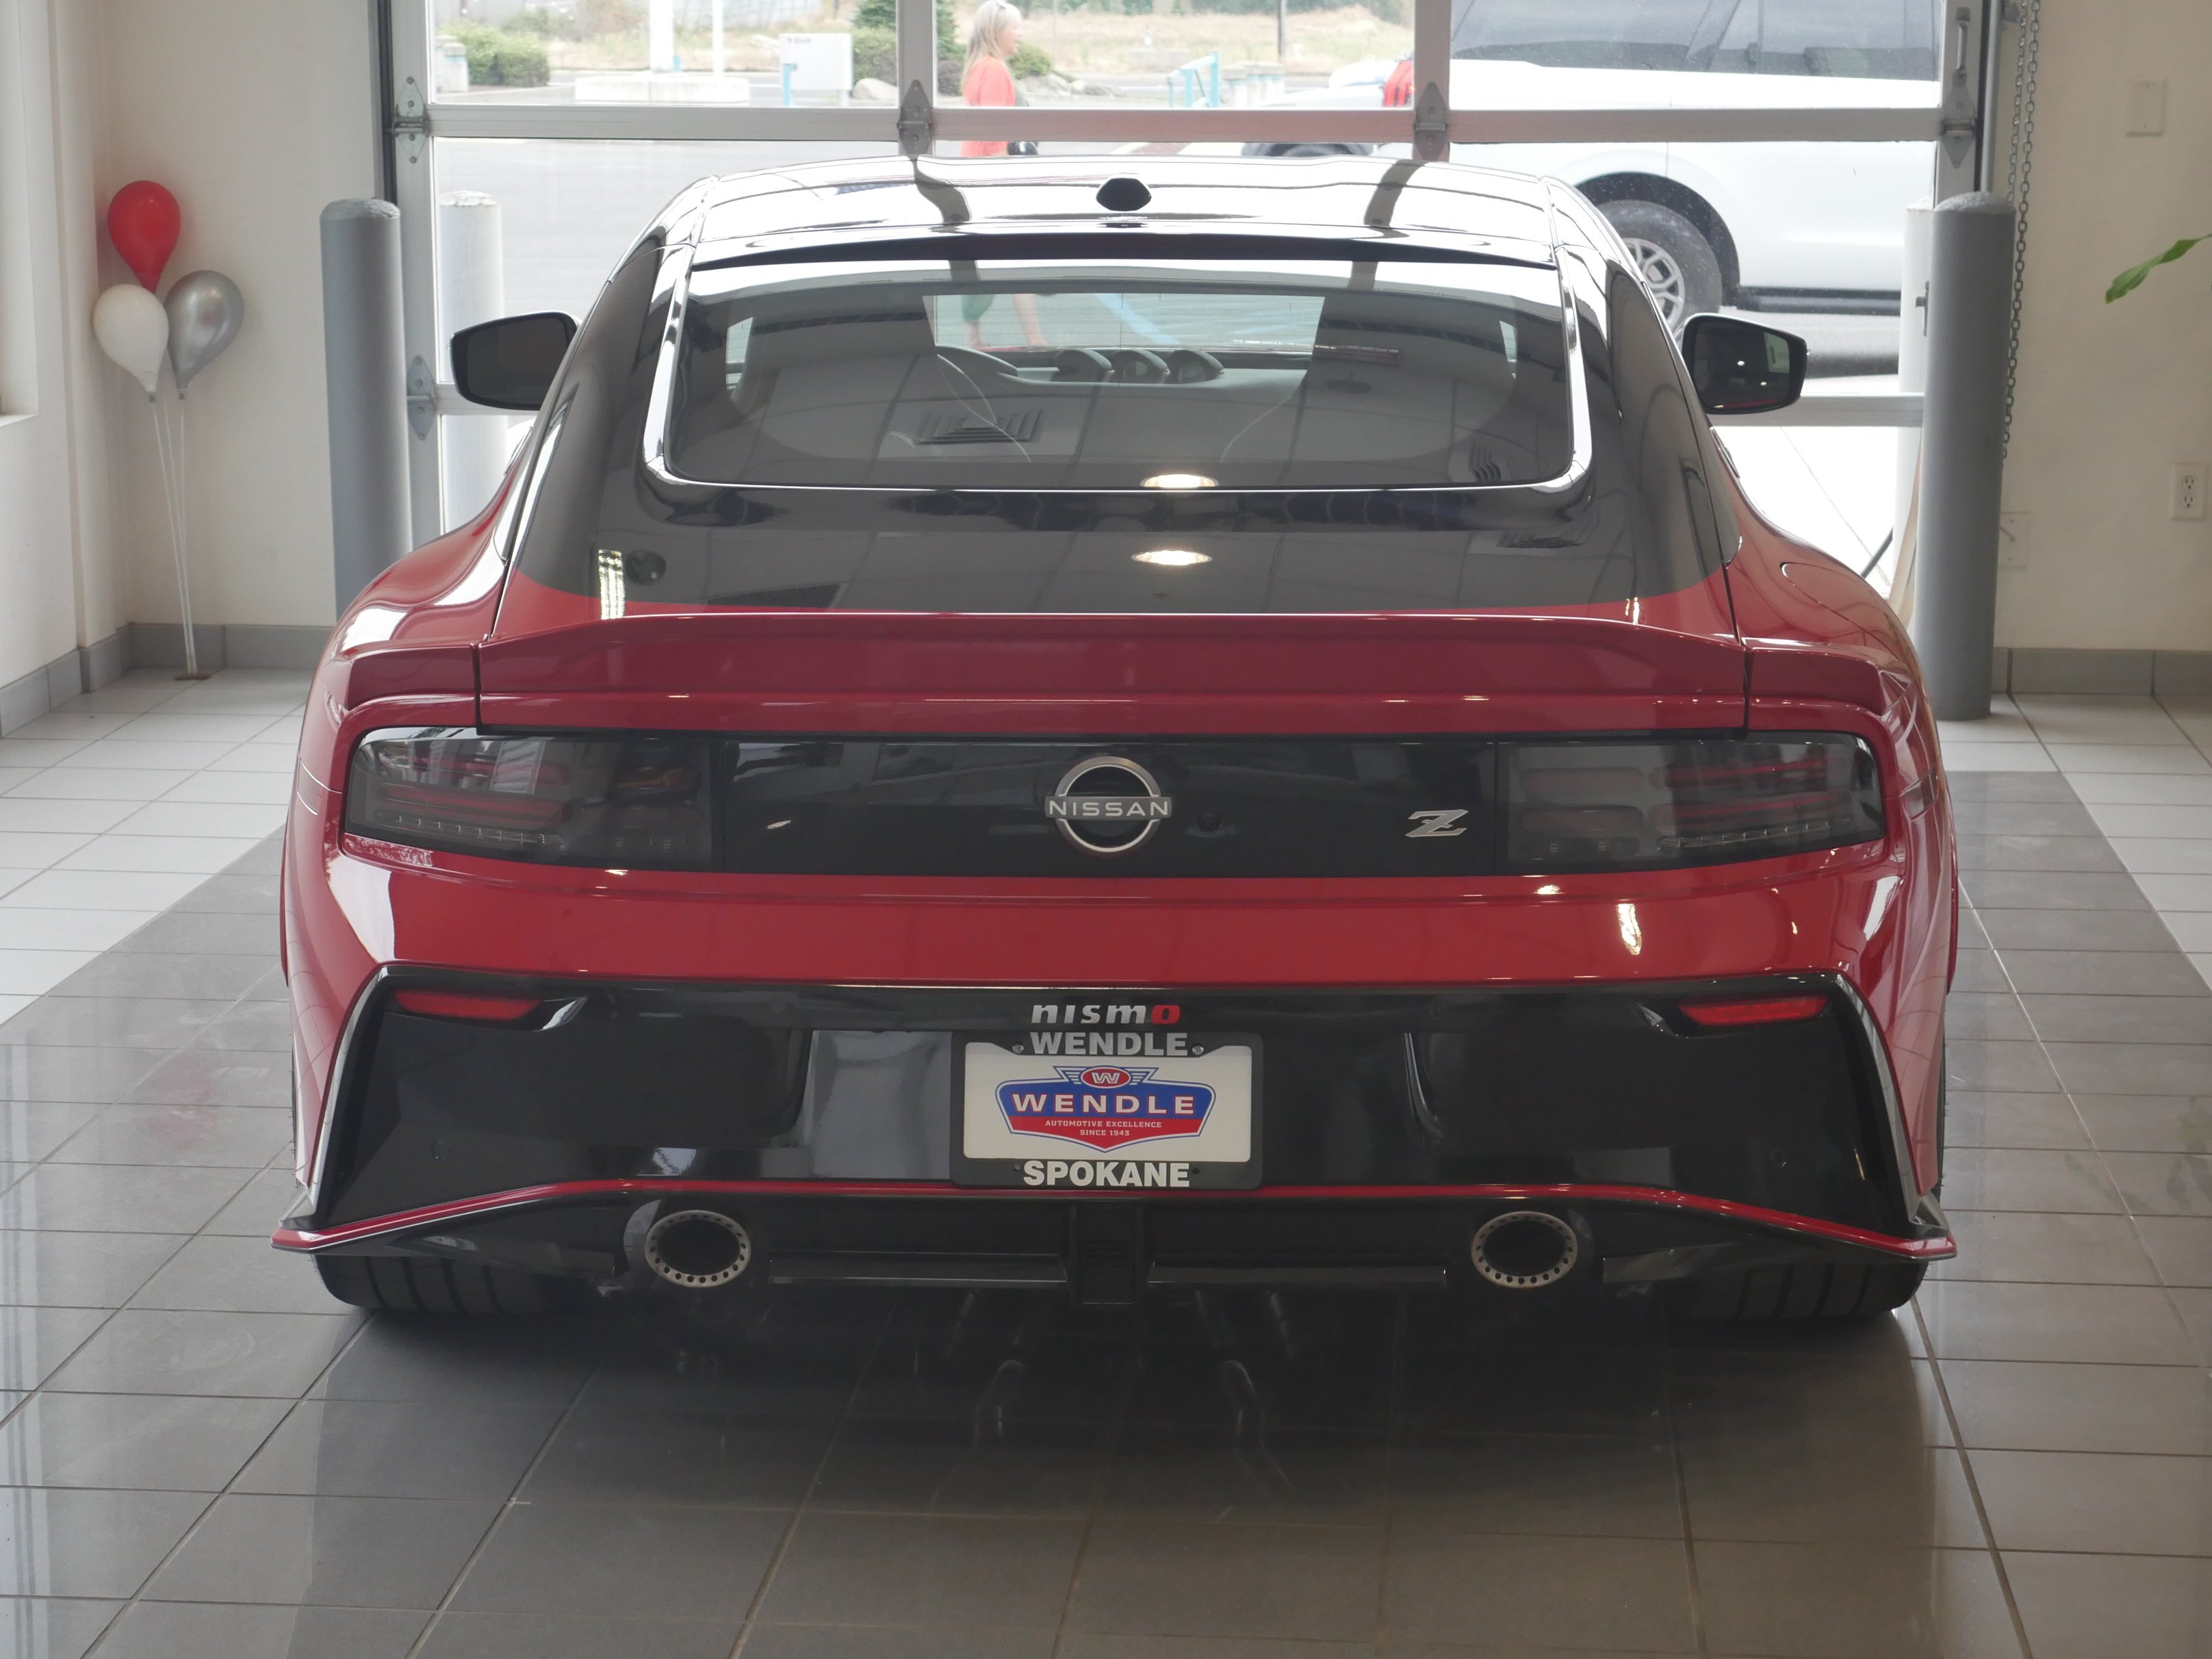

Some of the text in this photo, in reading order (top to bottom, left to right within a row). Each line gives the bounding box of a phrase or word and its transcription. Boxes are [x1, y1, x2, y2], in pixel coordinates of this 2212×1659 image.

[1049, 800, 1168, 816] NISSAN
[1405, 809, 1469, 838] Z
[1031, 1005, 1181, 1024] nismo
[1030, 1032, 1188, 1056] WENDLE
[1012, 1094, 1194, 1114] WENDLE
[1023, 1160, 1189, 1187] SPOKANE
